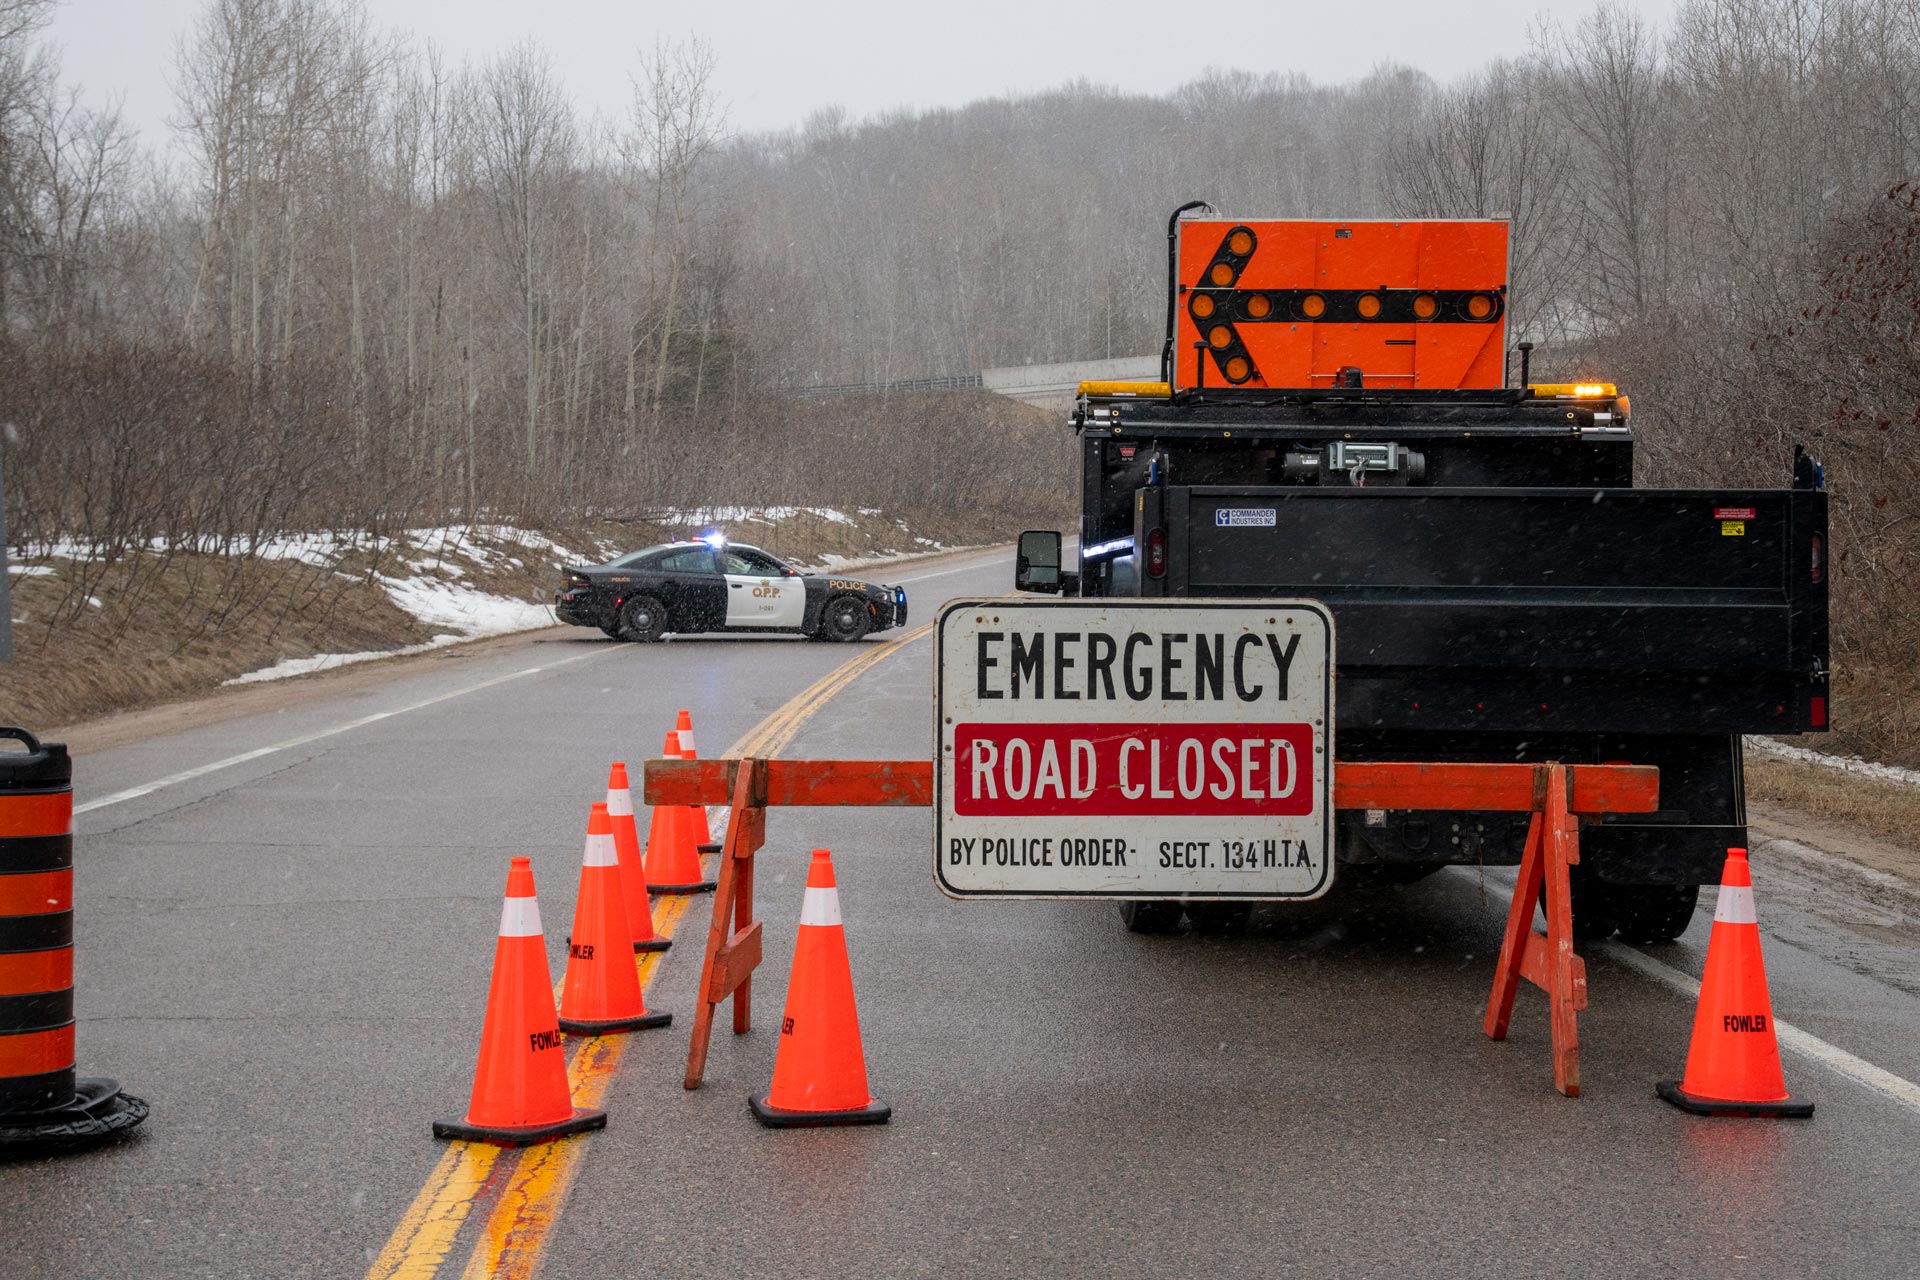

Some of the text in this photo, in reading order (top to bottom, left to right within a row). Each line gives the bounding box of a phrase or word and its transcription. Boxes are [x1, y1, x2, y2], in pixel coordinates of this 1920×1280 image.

[752, 587, 781, 598] O.P.P.
[829, 580, 867, 591] POLICE
[977, 631, 1301, 702] EMERGENCY
[971, 738, 1297, 800] ROAD CLOSED
[950, 838, 976, 865] BY
[982, 838, 1053, 866] POLICE
[1159, 841, 1215, 868] SECT.
[1222, 841, 1258, 868] 134
[1263, 839, 1317, 868] H.T.A.
[1723, 1015, 1767, 1032] FOWLER
[530, 1029, 561, 1051] FOWLE
